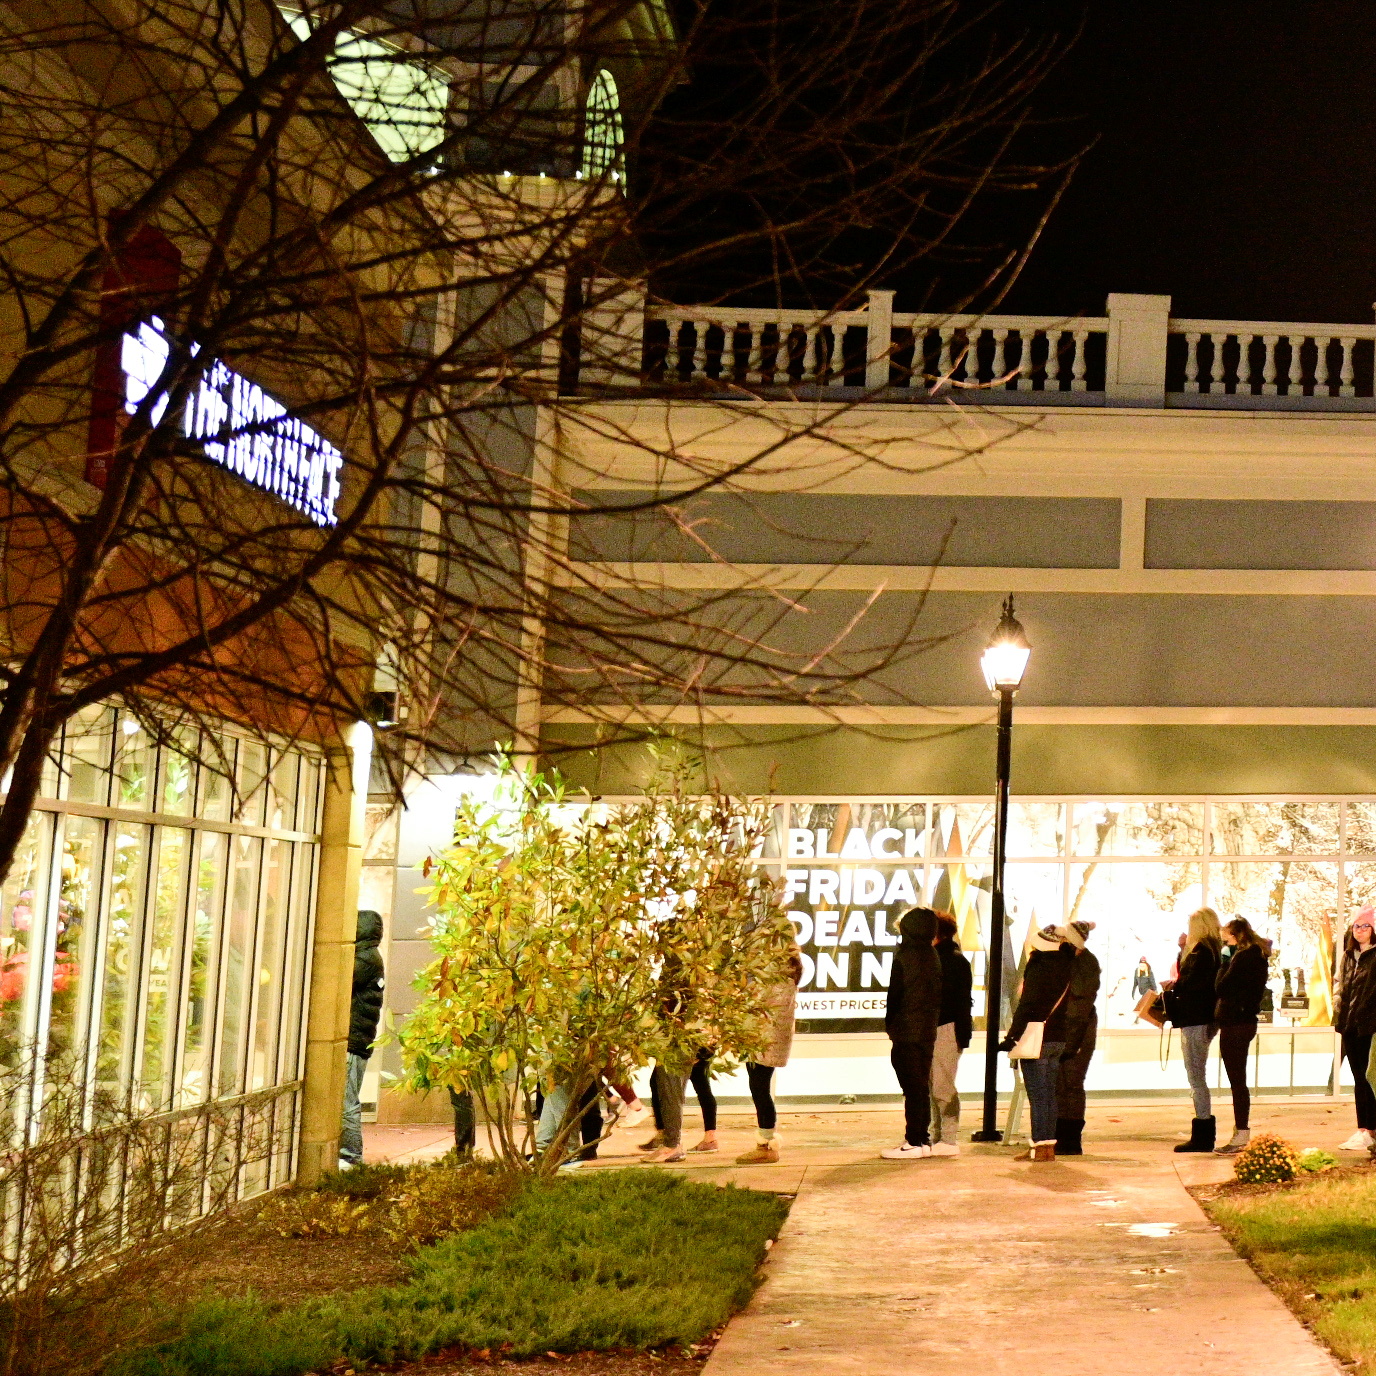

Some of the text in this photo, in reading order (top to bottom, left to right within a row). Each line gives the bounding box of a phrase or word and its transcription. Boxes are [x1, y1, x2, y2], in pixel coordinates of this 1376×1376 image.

[787, 828, 935, 859] BLACK
[785, 869, 944, 905] FRIDAY
[786, 910, 902, 947] DEAL
[794, 1000, 834, 1011] OWEST
